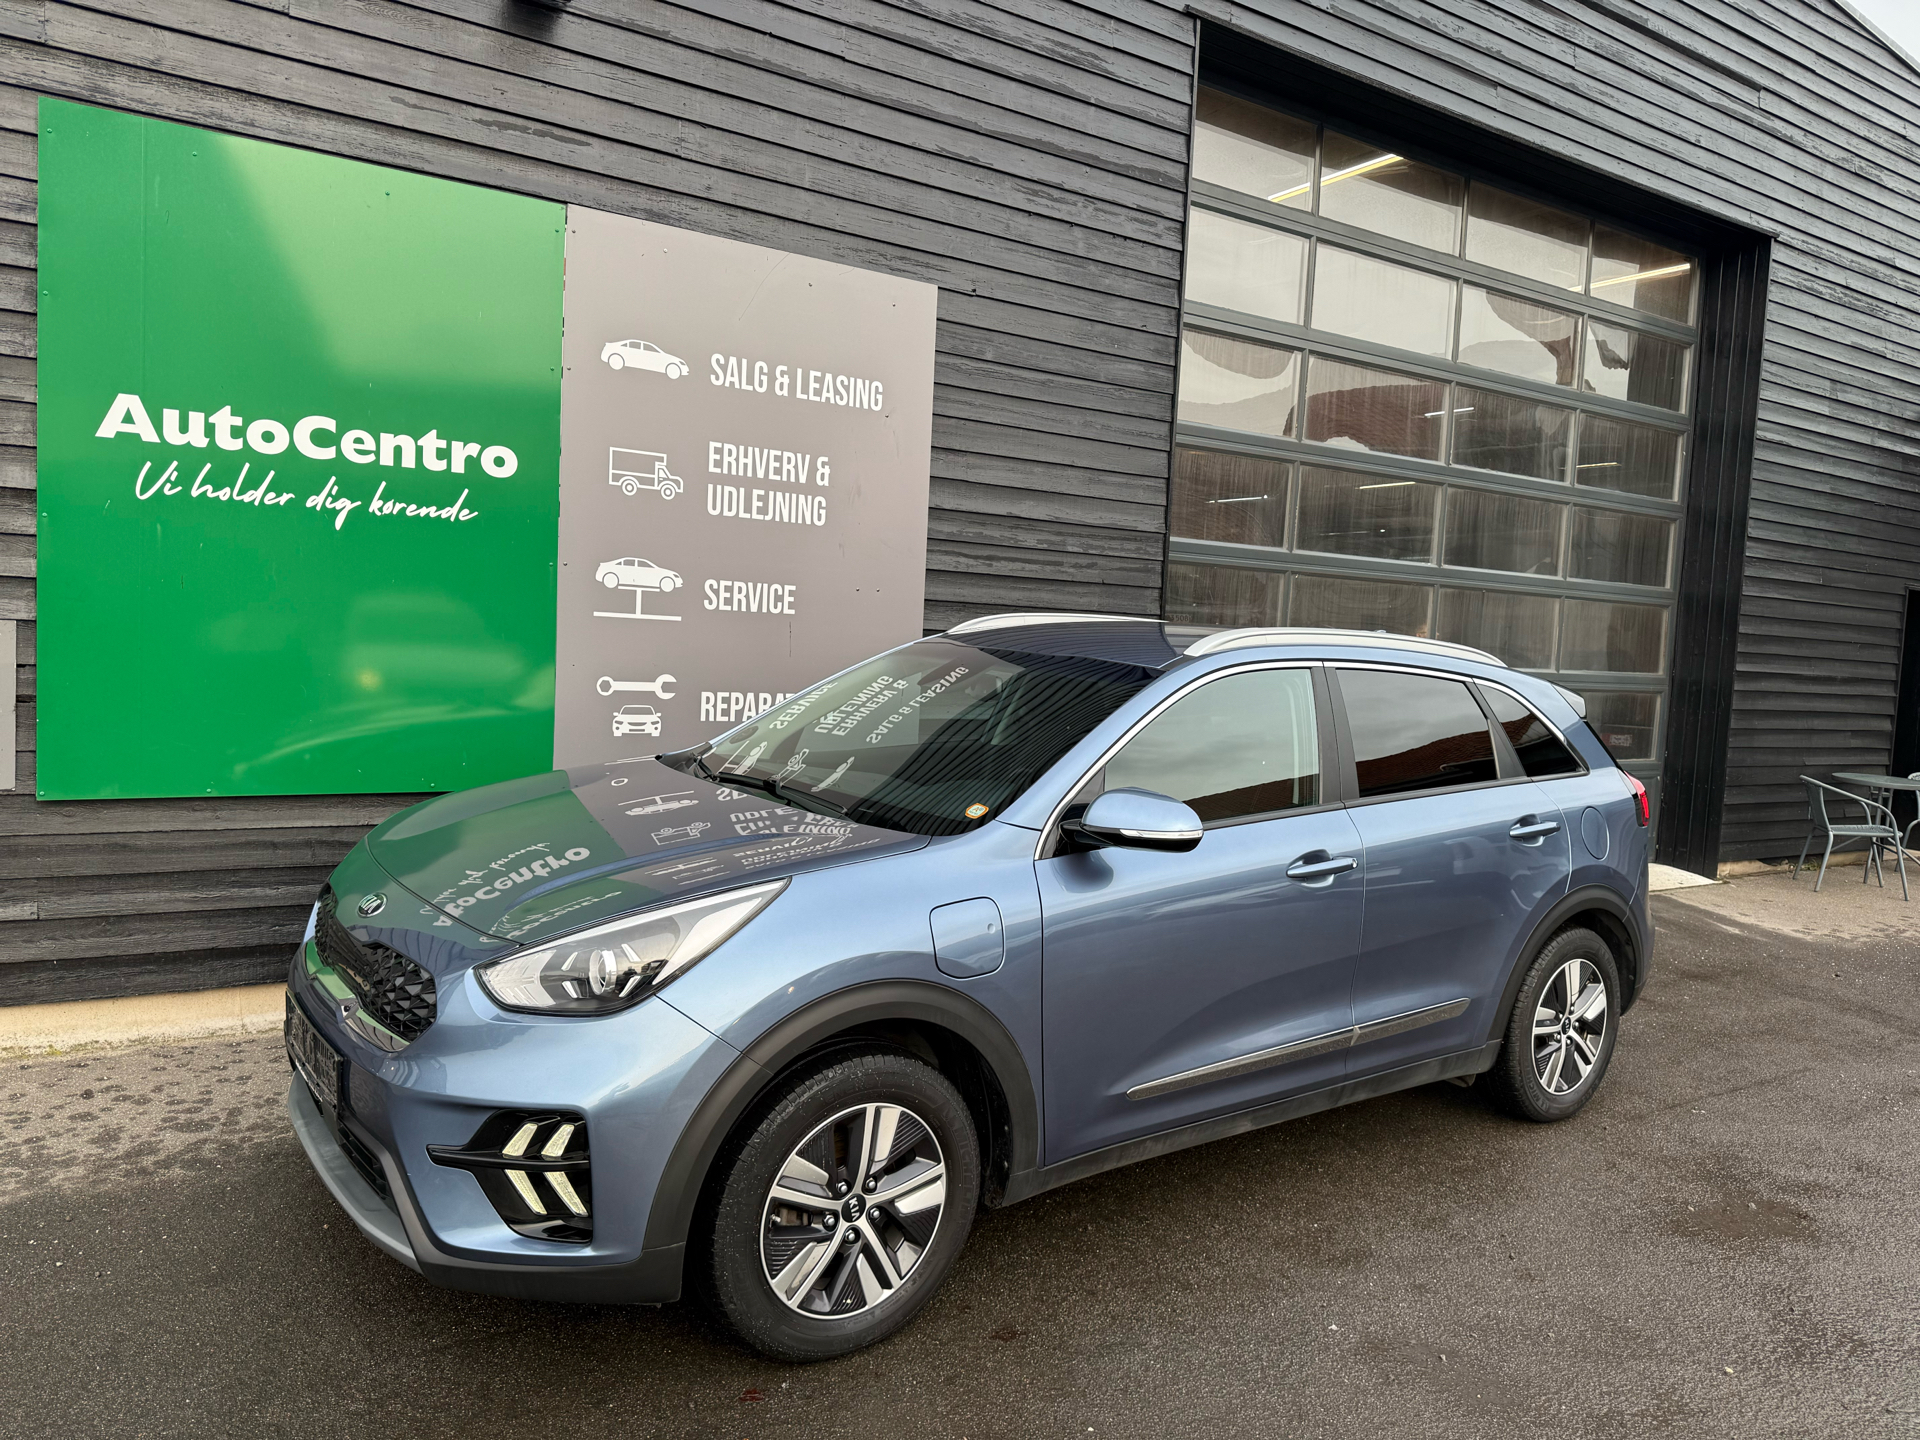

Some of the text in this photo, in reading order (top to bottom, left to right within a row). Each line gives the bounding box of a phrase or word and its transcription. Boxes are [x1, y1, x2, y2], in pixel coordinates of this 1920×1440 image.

[710, 353, 883, 411] SALG & LEASING
[95, 393, 518, 478] AutoCentro
[708, 441, 831, 487] ERHVERV &
[135, 460, 478, 530] Vi holder dig kørende
[707, 483, 827, 526] UDLEJNING
[703, 579, 796, 615] SERVICE
[848, 1196, 860, 1222] KIA
